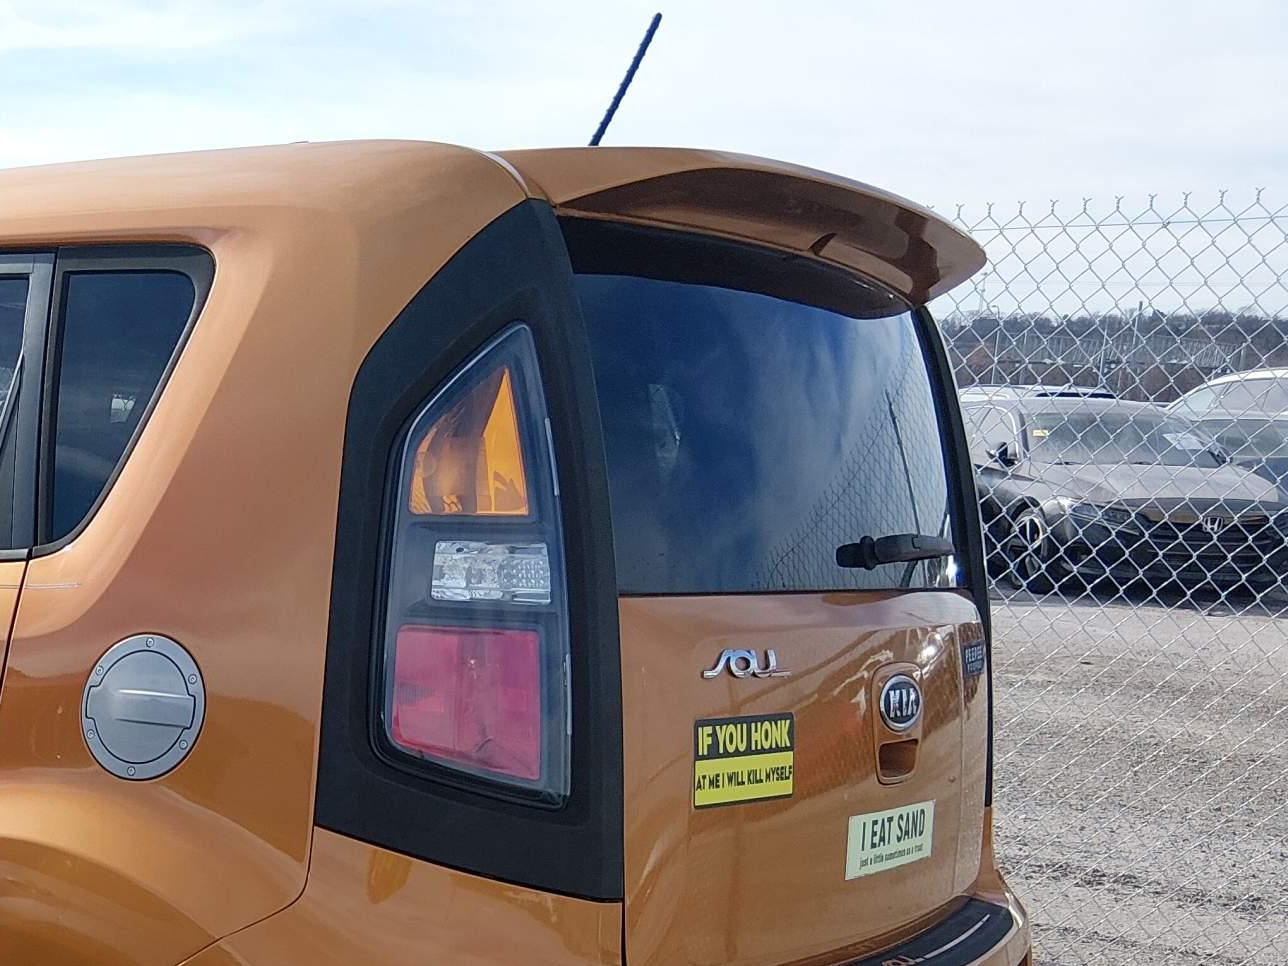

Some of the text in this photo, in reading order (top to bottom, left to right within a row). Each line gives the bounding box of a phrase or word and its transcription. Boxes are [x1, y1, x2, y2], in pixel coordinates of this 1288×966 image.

[887, 687, 917, 718] KIA
[698, 719, 791, 756] IF YOU HONK
[695, 774, 707, 792] AT
[708, 773, 721, 790] ME
[726, 771, 746, 788] WILL
[747, 768, 764, 785] KILL
[764, 765, 793, 783] MYSELF
[861, 808, 926, 852] I EAT SAND
